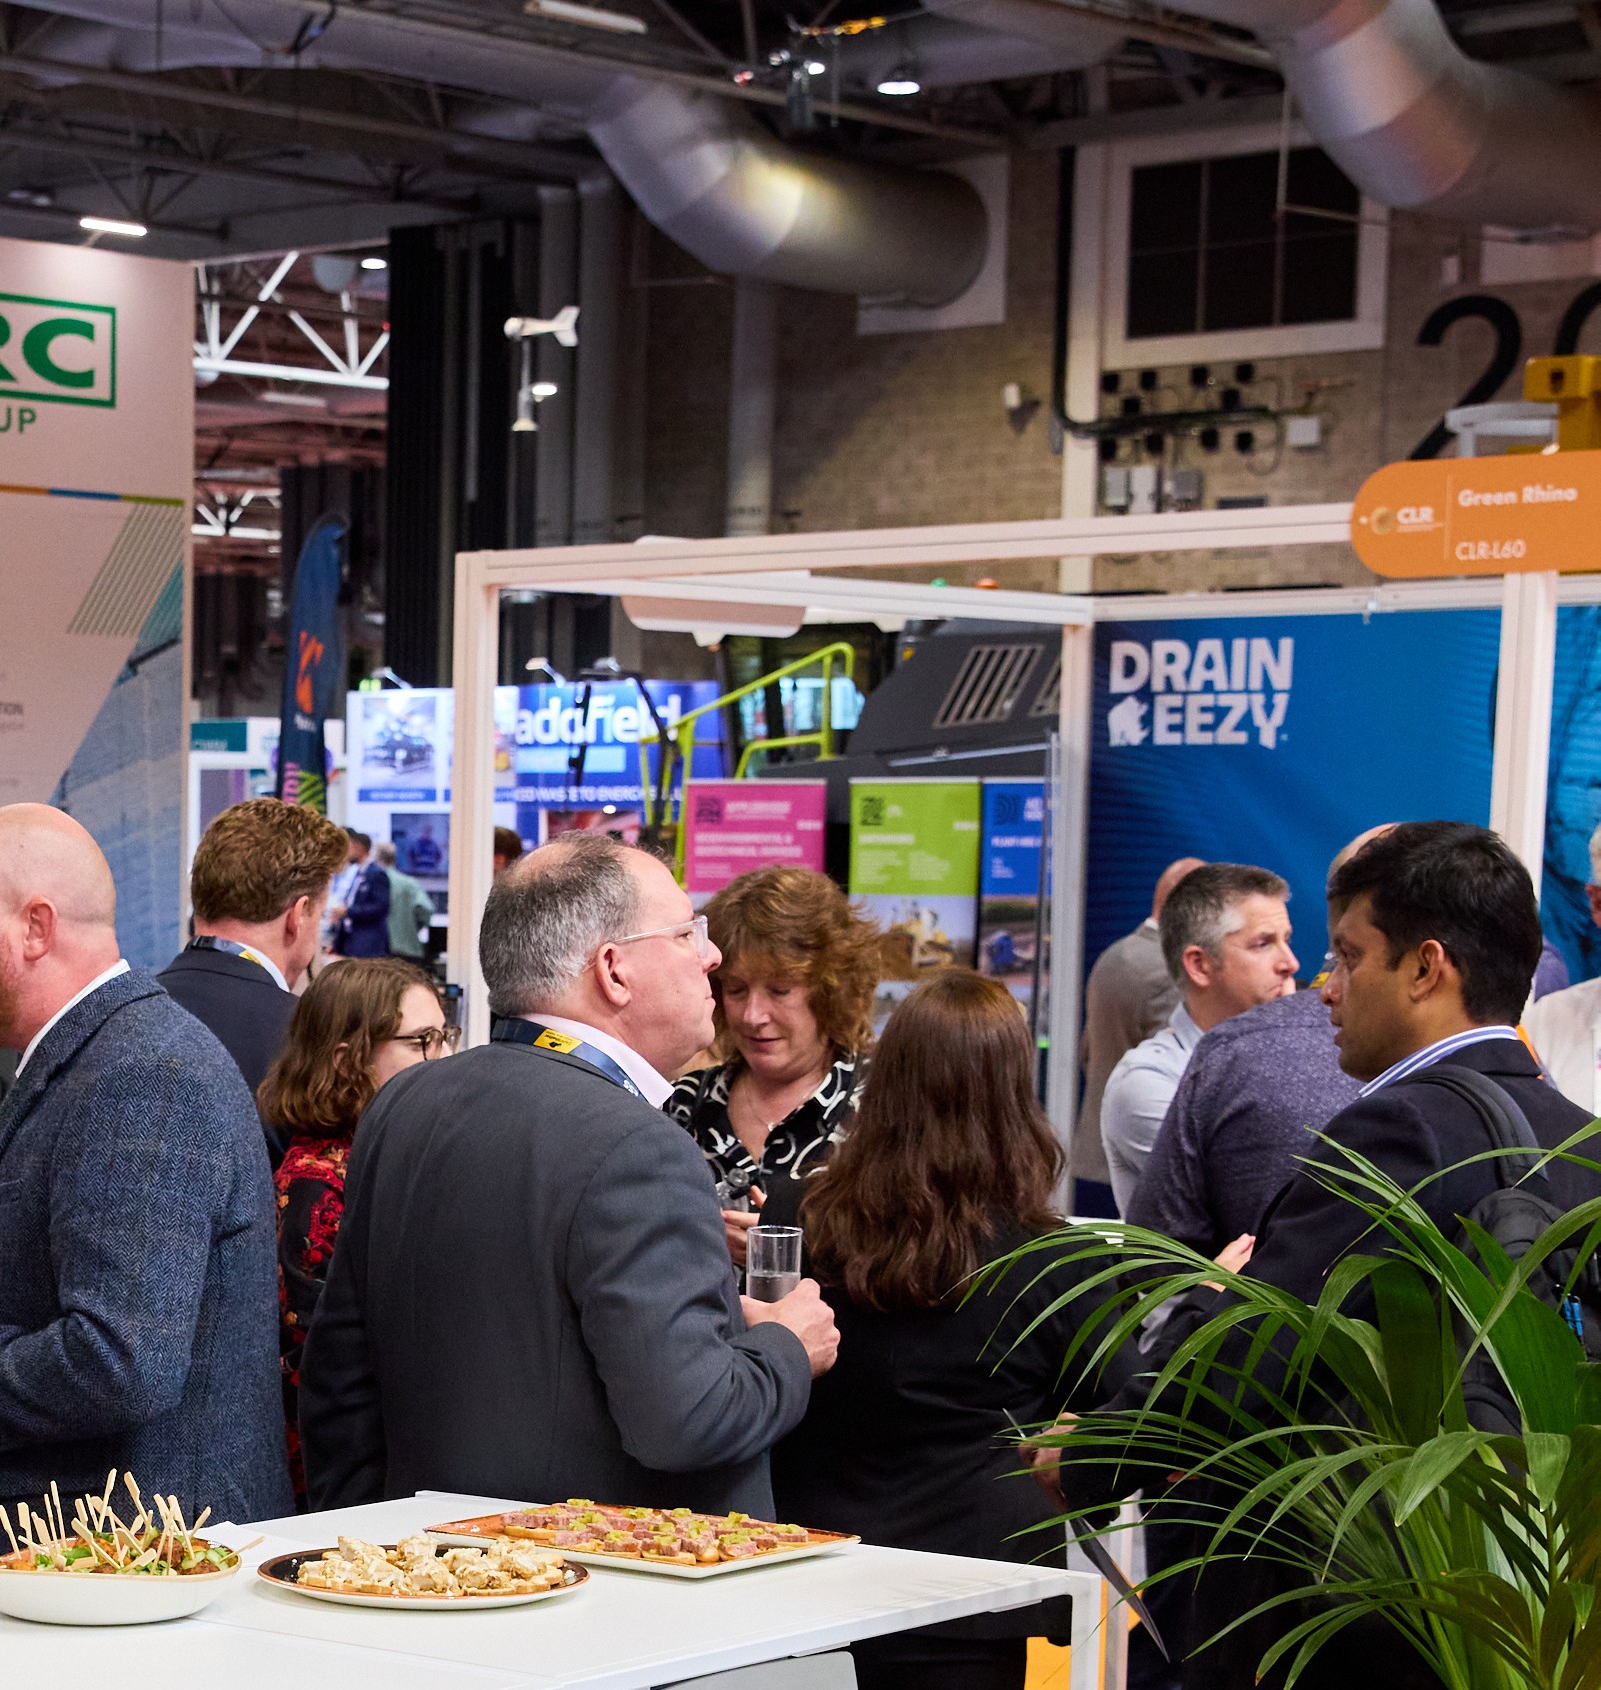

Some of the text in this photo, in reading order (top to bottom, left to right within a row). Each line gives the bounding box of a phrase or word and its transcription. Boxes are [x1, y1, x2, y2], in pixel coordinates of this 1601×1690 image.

[1458, 484, 1578, 507] Green Rhino
[1397, 506, 1434, 525] CLR
[1455, 538, 1527, 561] CLR-L60
[1109, 637, 1294, 694] DRAIN
[1153, 692, 1289, 750] EEZY
[538, 785, 578, 802] WASE
